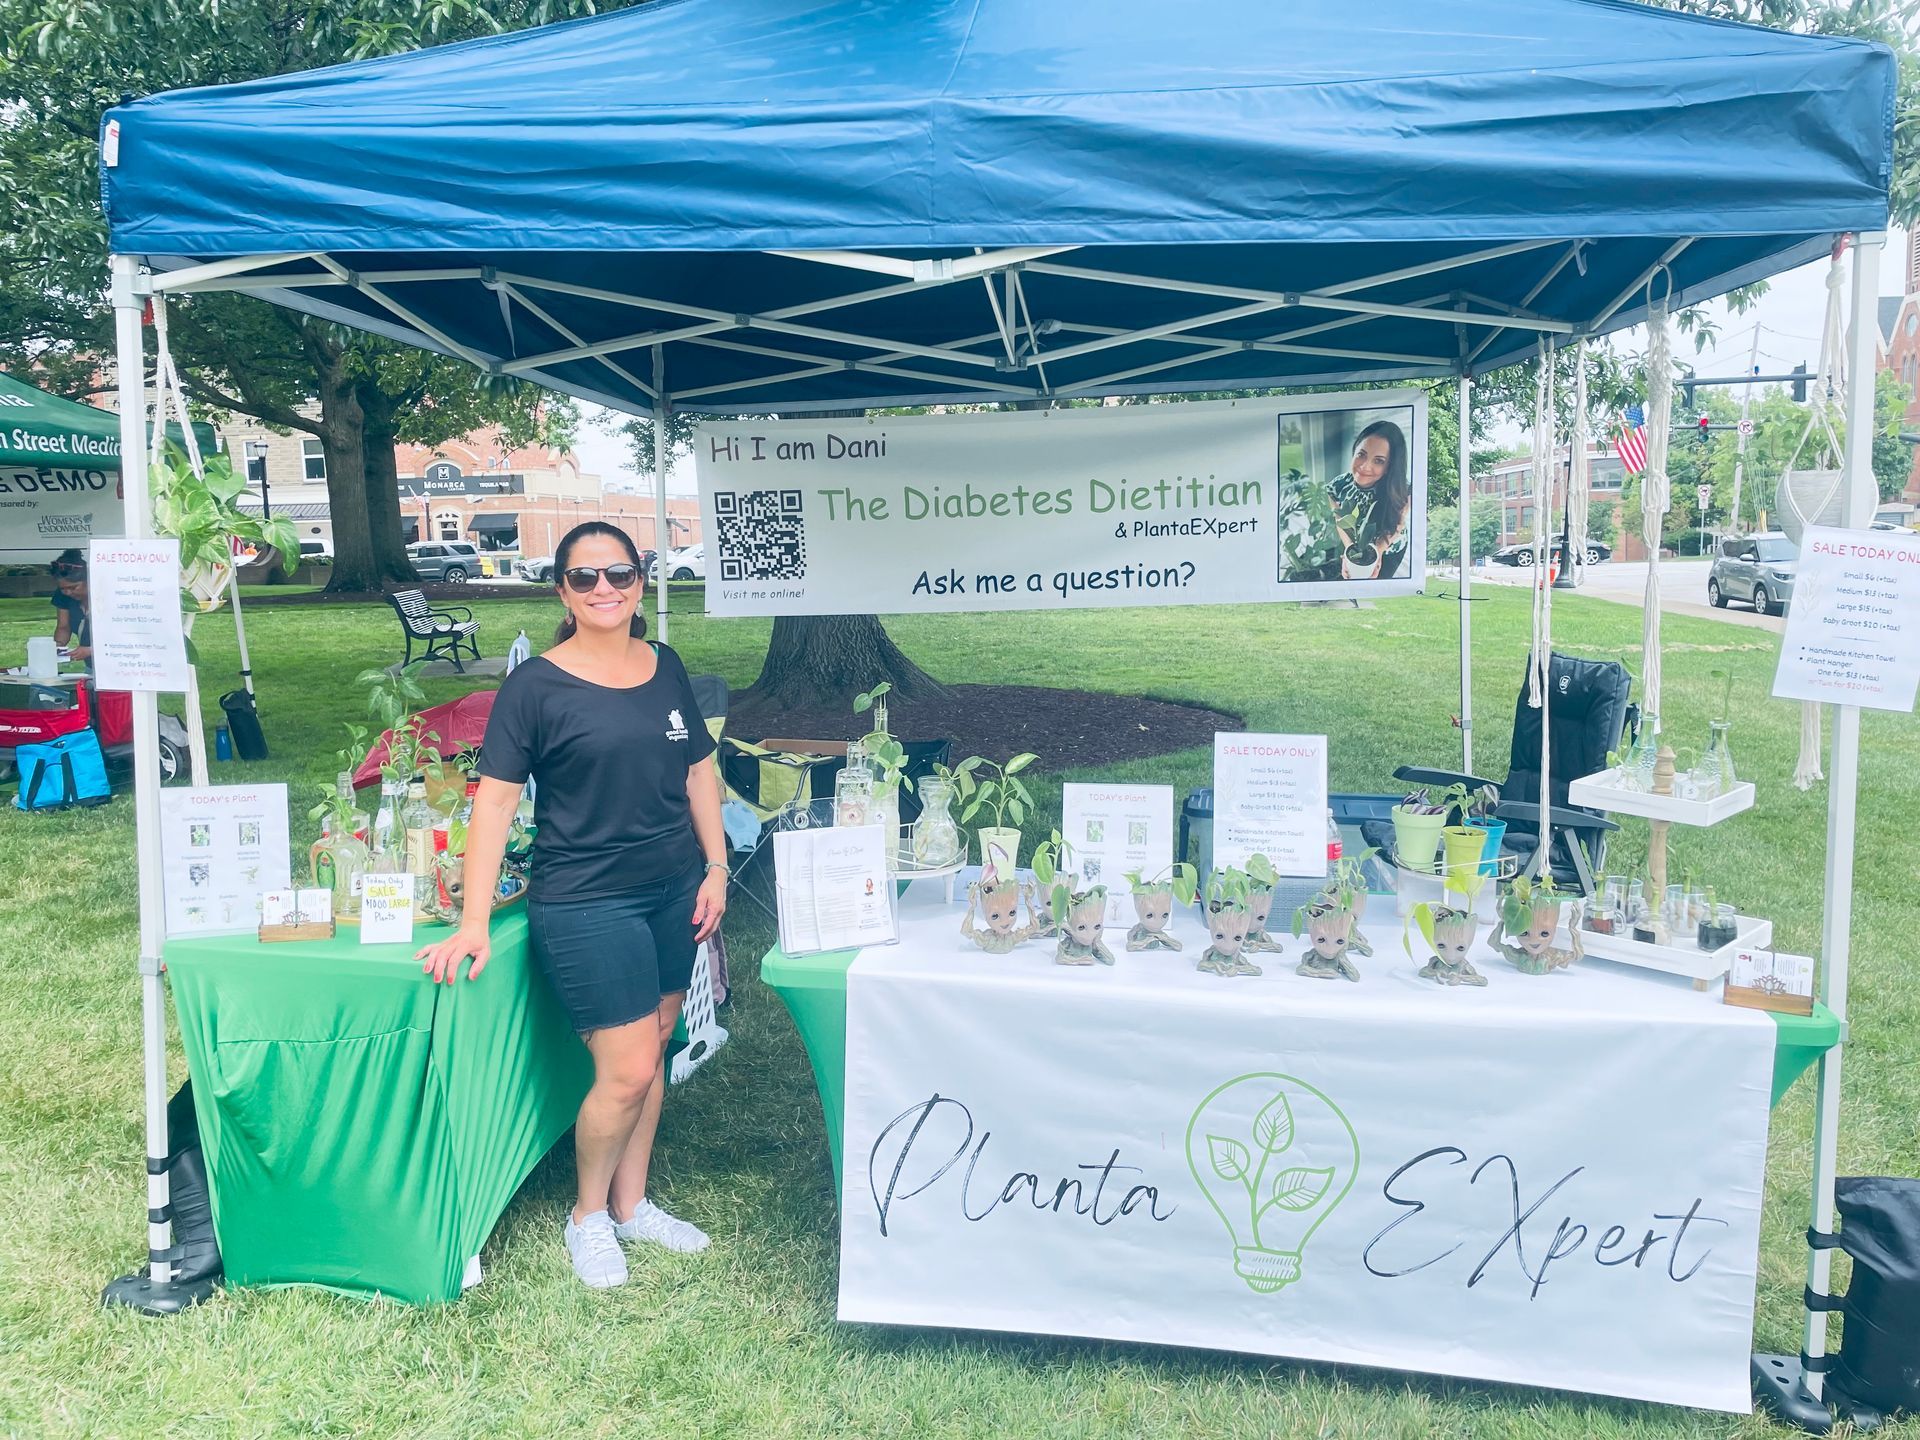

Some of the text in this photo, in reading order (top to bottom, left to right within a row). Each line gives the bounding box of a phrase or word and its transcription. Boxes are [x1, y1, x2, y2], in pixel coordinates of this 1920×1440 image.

[12, 428, 68, 454] Street
[711, 433, 887, 462] Hi I am Dani
[13, 469, 107, 492] DEMO
[817, 474, 1262, 521] The Diabetes Dietitian
[1115, 517, 1258, 538] & PlantaEXpert
[96, 553, 171, 563] SALE TODAY ONLY
[1812, 541, 1848, 556] SALE
[1850, 545, 1895, 560] TODAY
[912, 561, 1196, 598] Ask me a question?
[722, 588, 805, 600] Visit me online!
[1836, 603, 1857, 613] Large
[1809, 646, 1847, 658] Handmade
[1223, 746, 1317, 757] SALE TODAY ONLY
[232, 794, 257, 802] Plant
[370, 886, 396, 898] SALE
[869, 1092, 1179, 1237] Planta
[1363, 1146, 1729, 1301] EXpert
